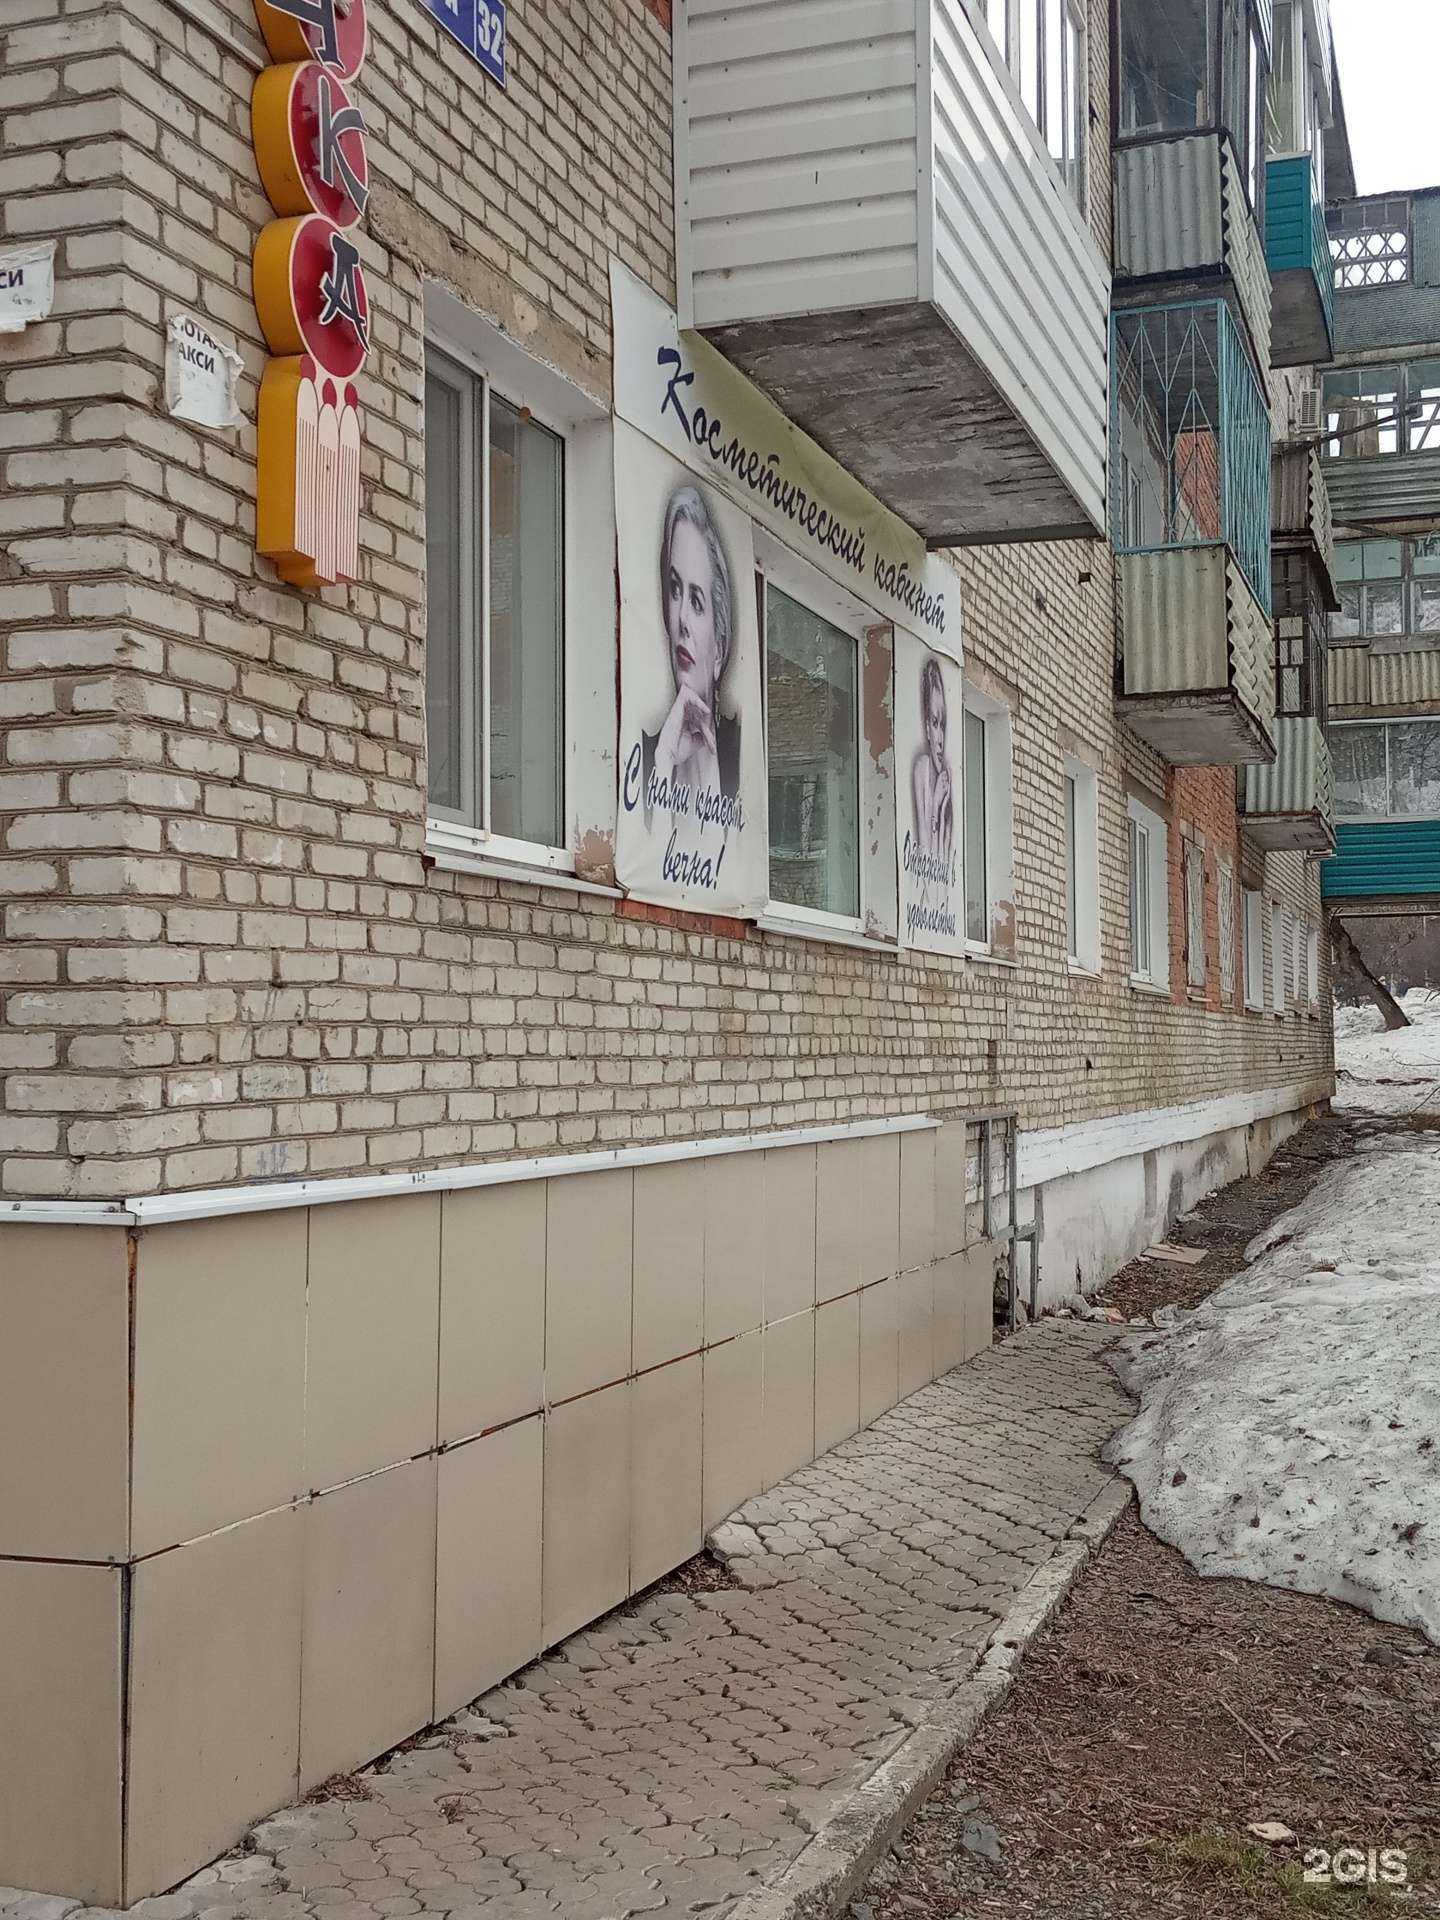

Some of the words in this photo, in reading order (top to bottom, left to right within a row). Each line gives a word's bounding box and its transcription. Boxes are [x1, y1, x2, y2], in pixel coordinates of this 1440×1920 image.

[477, 0, 503, 66] 32
[657, 346, 866, 574] Косметический
[874, 553, 946, 635] кабинет
[623, 742, 642, 812] С
[647, 766, 690, 816] нами
[662, 827, 726, 890] вечна!
